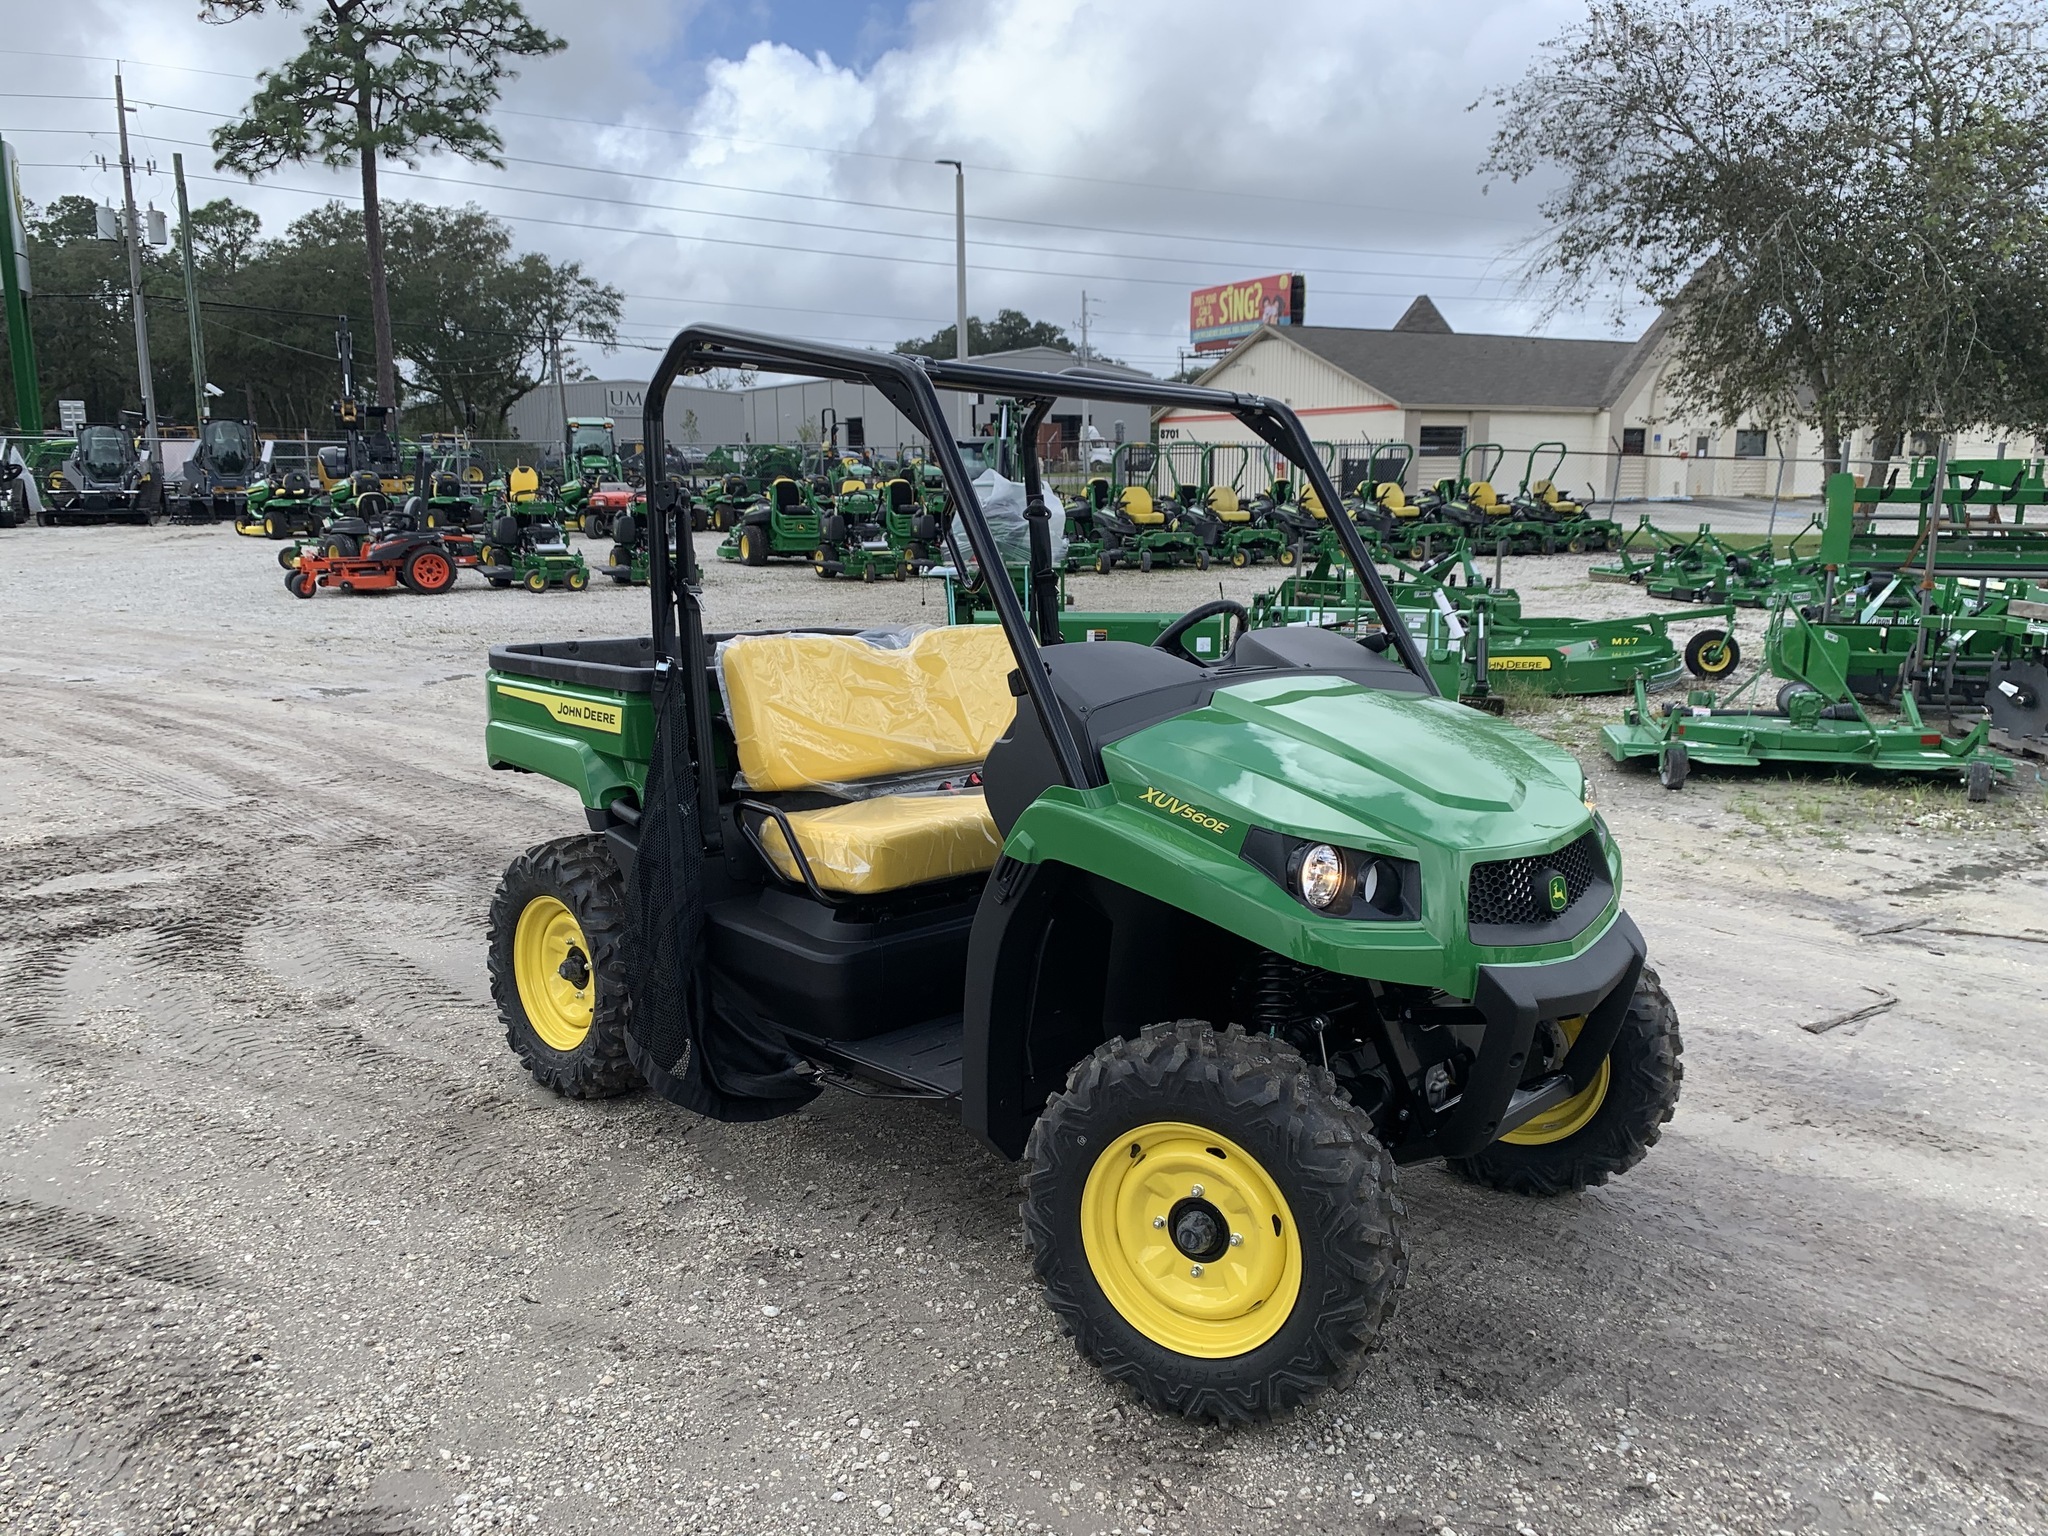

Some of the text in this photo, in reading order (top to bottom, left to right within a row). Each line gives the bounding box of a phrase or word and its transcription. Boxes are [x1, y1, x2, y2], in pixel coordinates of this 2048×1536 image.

[1160, 429, 1179, 439] 8701
[1489, 660, 1543, 669] HN DEERE
[557, 702, 616, 725] JOHN DEERE
[1138, 786, 1230, 835] XUV560E
